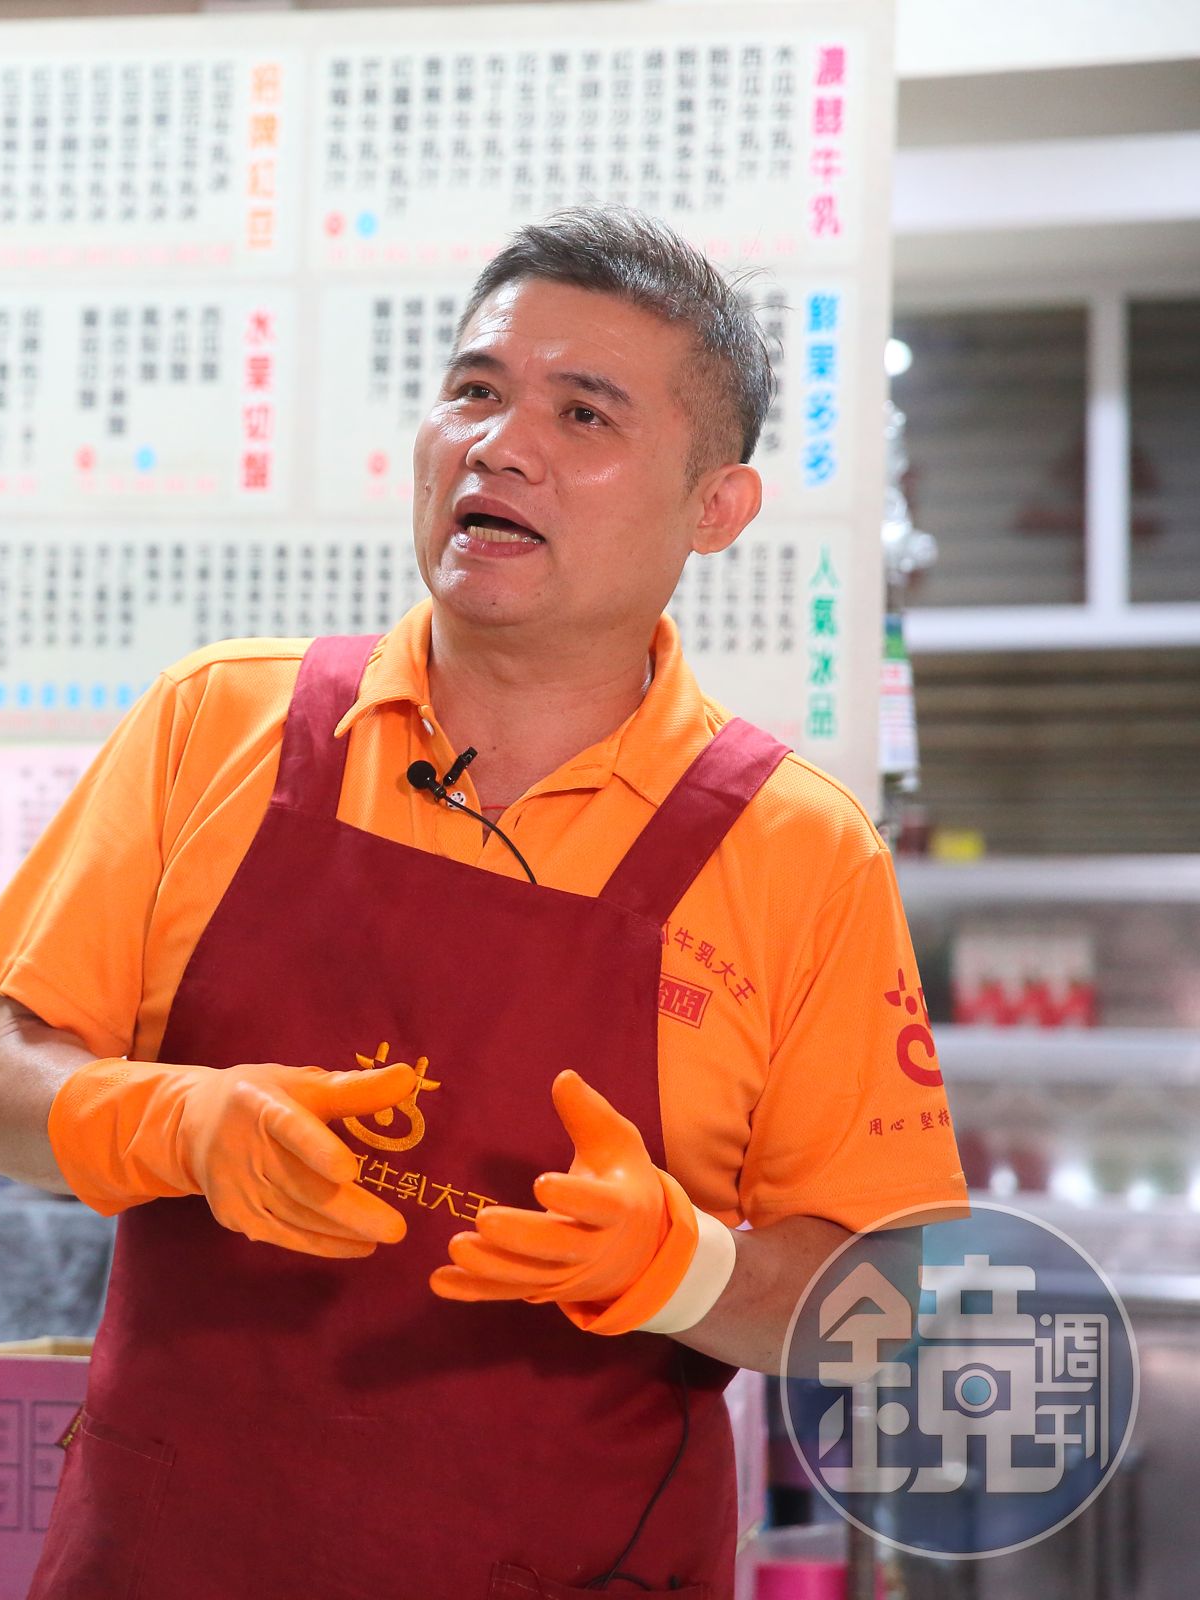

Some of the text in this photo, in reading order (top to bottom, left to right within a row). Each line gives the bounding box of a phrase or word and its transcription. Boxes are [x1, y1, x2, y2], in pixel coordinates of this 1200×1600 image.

[809, 46, 846, 236] 濃醇牛乳
[240, 307, 277, 492] 水果切盤
[802, 293, 840, 487] 鮮果多多
[806, 543, 839, 738] 人氣冰品
[868, 1117, 905, 1136] 用心
